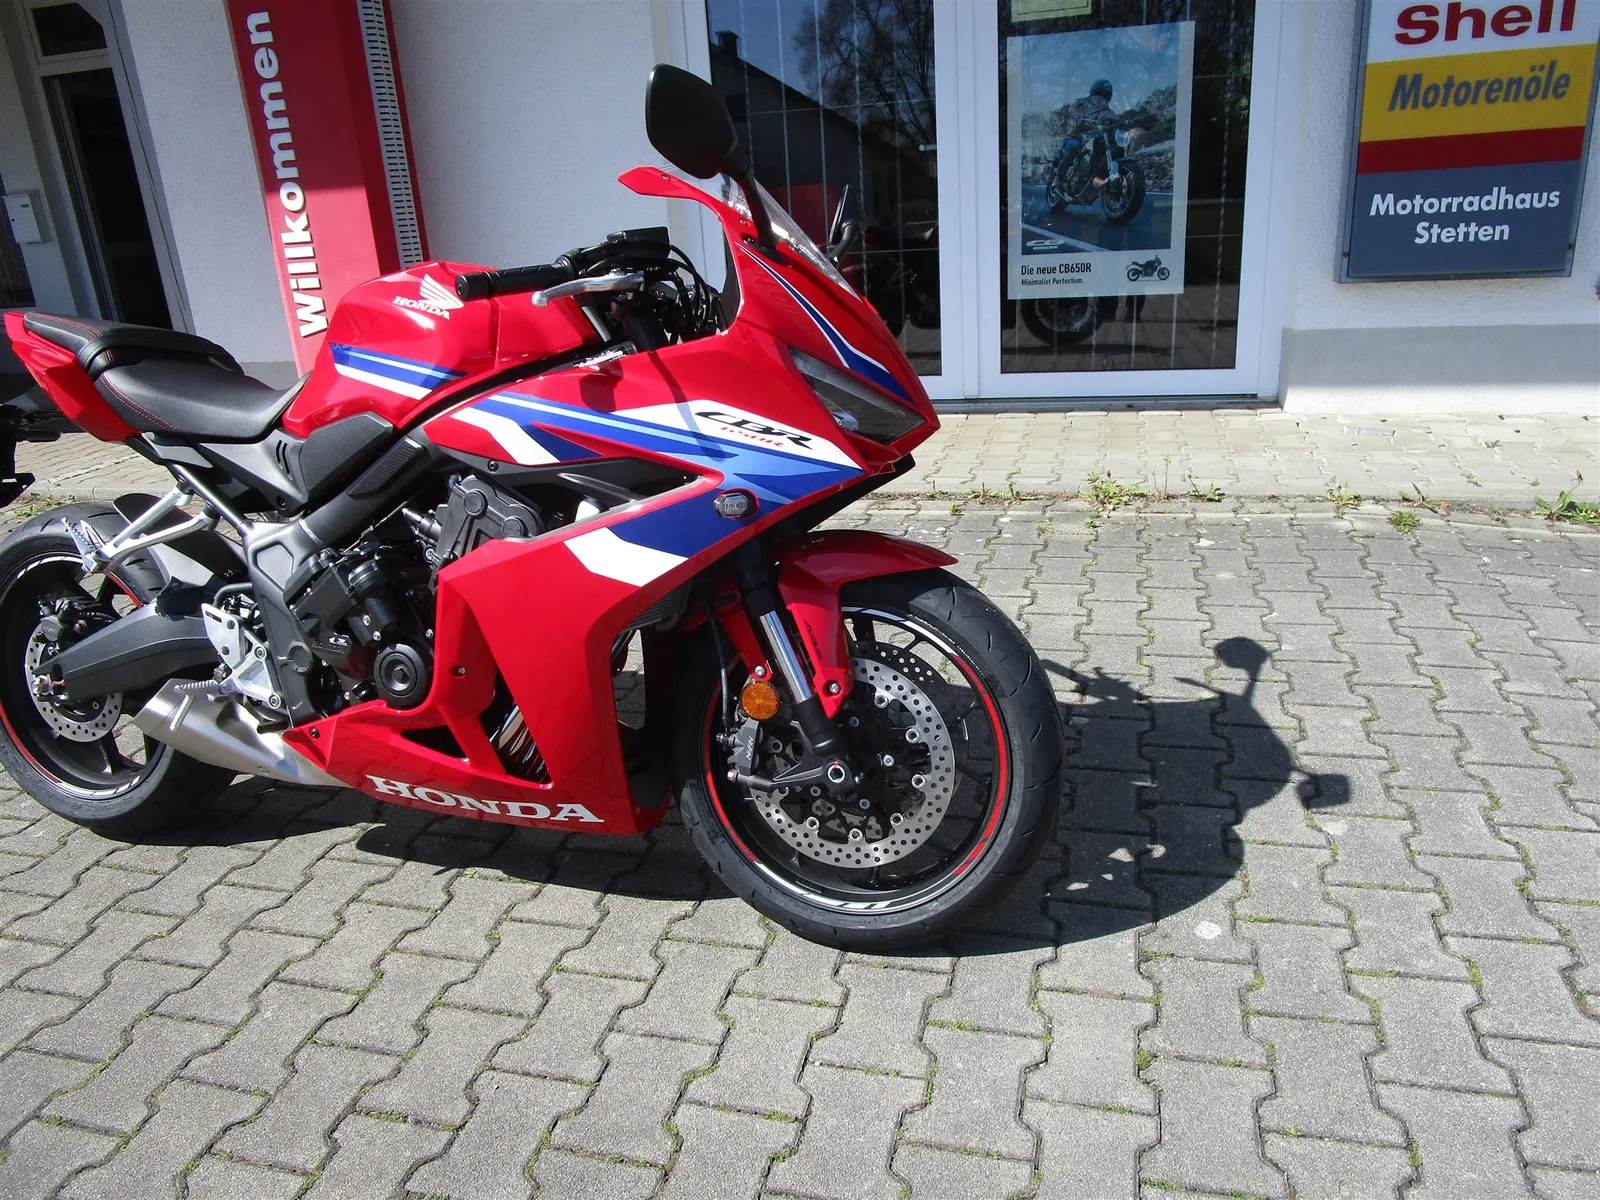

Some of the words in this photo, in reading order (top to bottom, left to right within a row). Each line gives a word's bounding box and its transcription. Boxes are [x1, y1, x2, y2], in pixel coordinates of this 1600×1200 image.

[1394, 0, 1576, 45] Shell
[1387, 59, 1571, 112] Motorenöle
[246, 10, 328, 338] Willkommen
[1369, 186, 1561, 217] Motorradhaus
[1413, 220, 1510, 245] Stetten
[1021, 264, 1034, 275] Die
[1036, 265, 1057, 274] neue
[1058, 262, 1091, 273] CB650R
[1021, 277, 1051, 286] Minimalist
[1052, 276, 1084, 285] Perfection.
[392, 295, 451, 320] HONDA
[695, 411, 814, 451] CBR
[365, 773, 605, 823] HONDA
